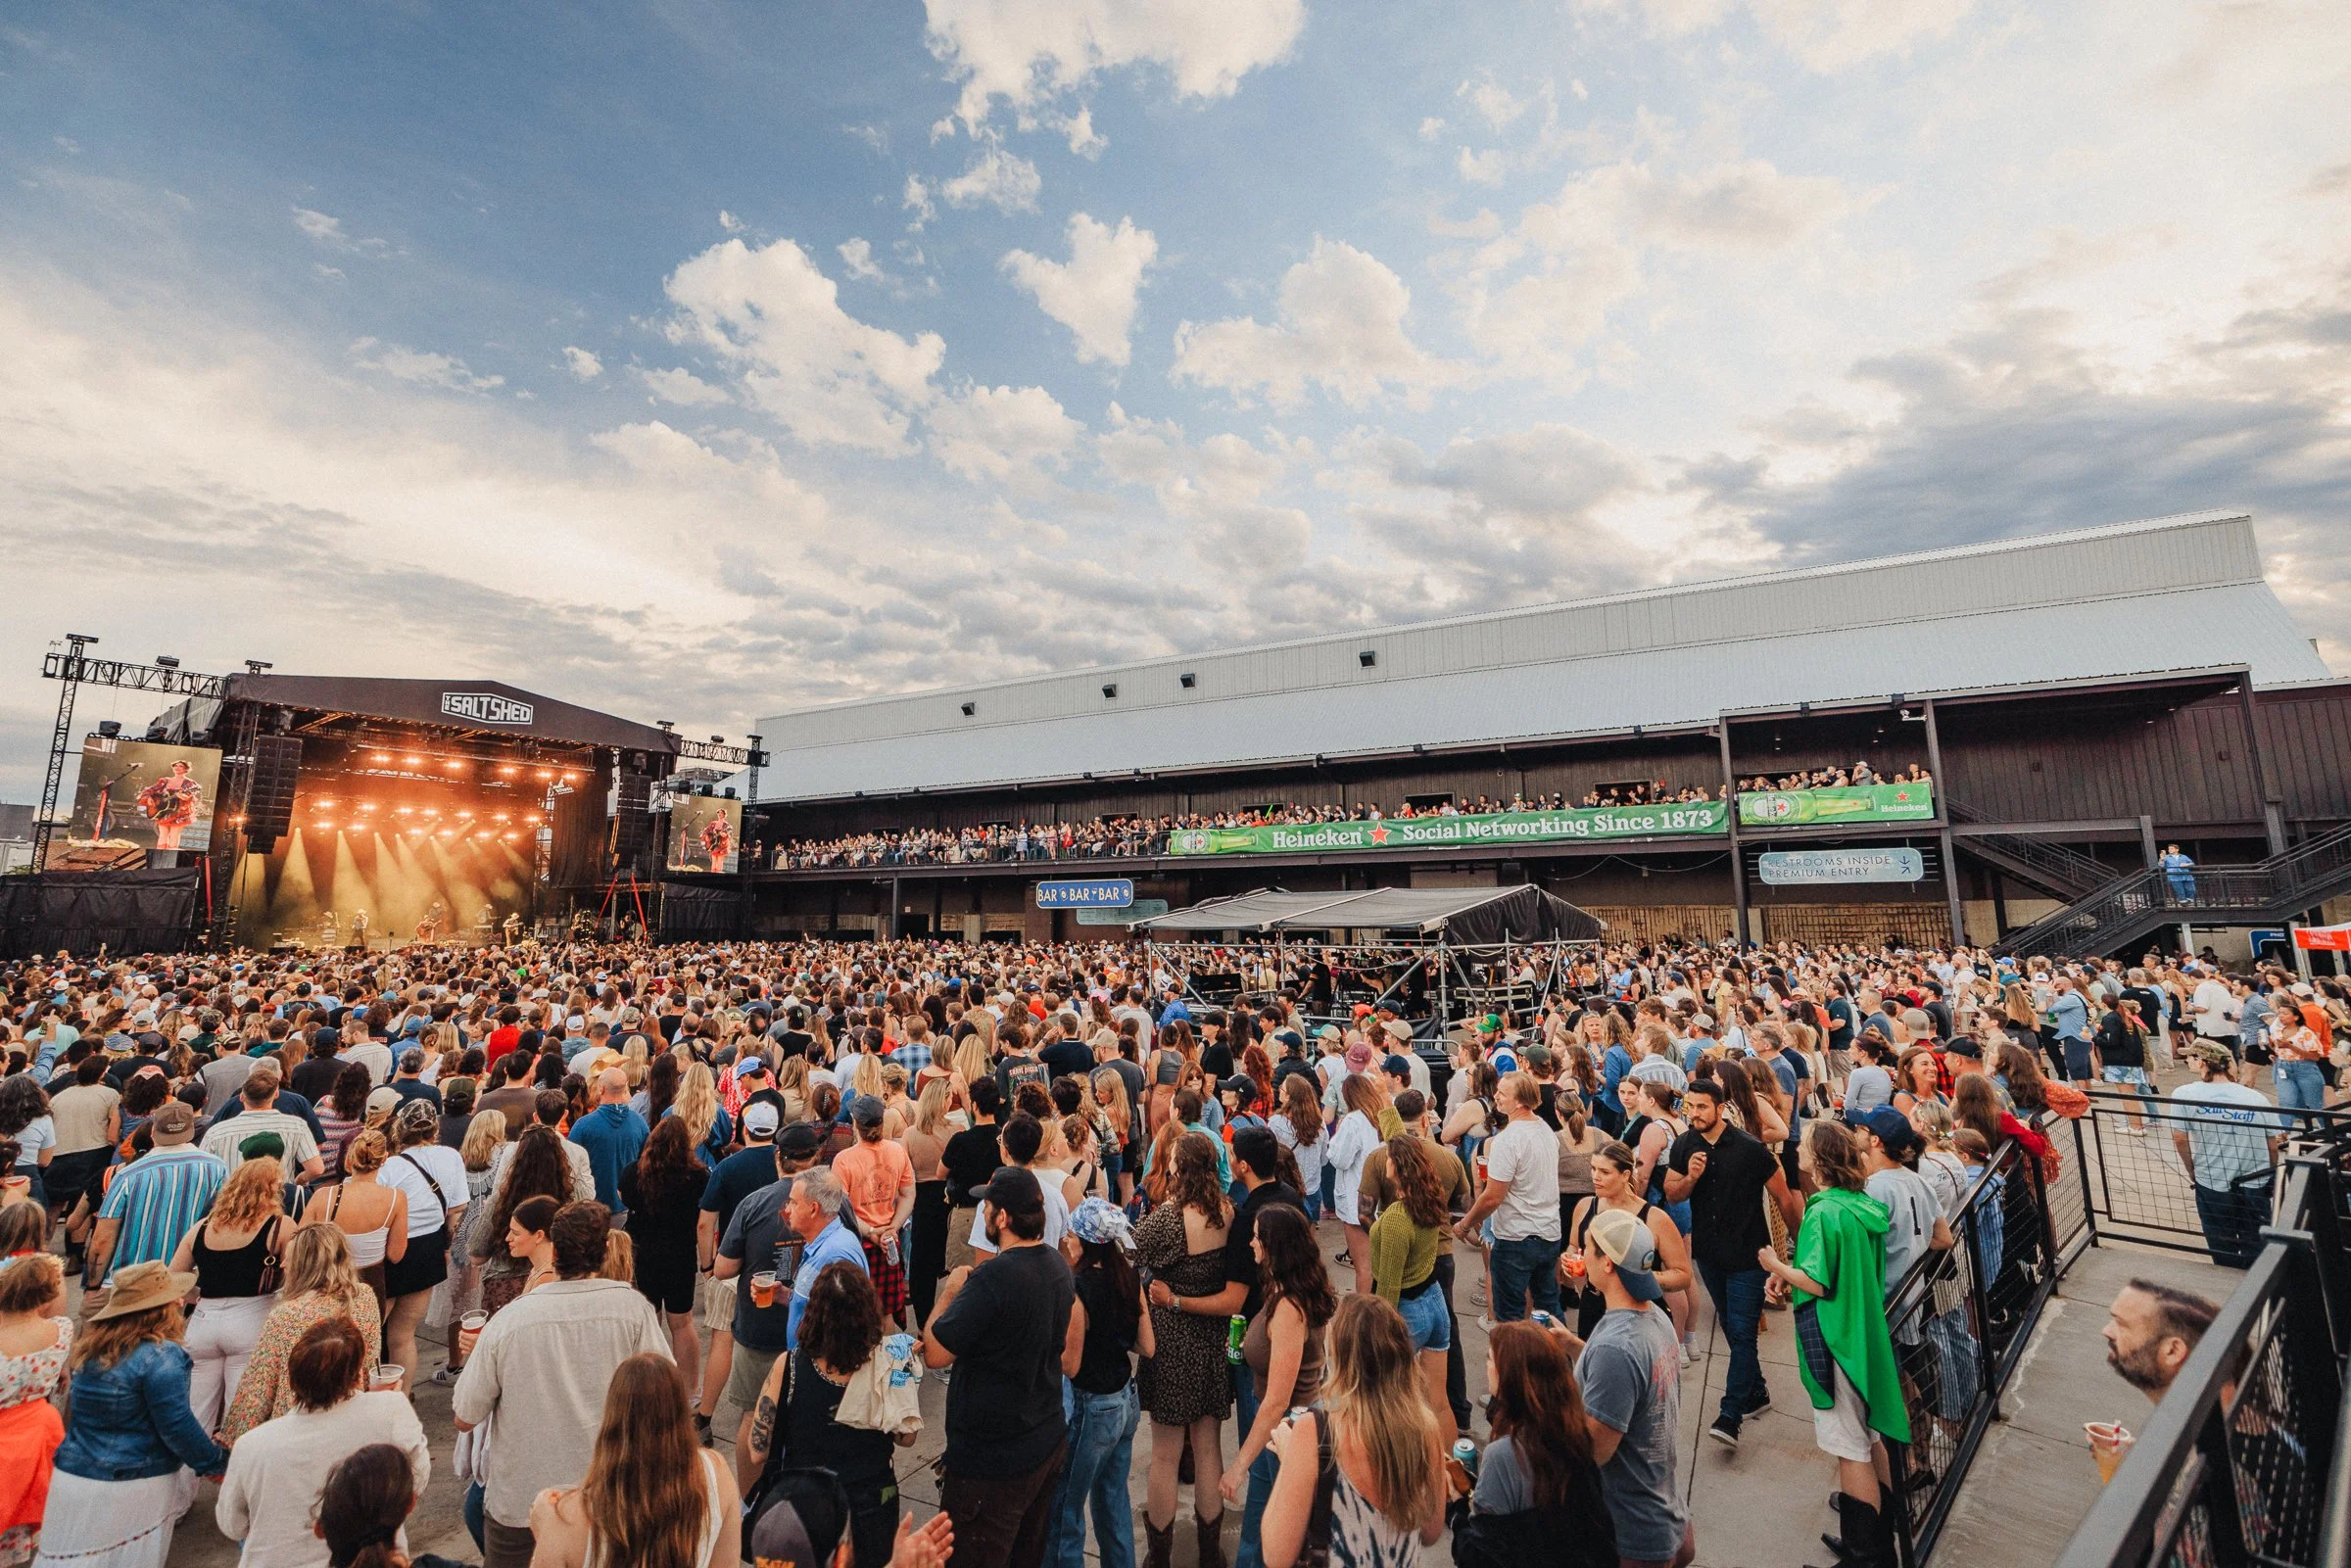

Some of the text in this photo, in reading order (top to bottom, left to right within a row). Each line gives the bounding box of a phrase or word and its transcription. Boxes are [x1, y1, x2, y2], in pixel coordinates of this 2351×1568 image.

[1881, 803, 1928, 813] Heineken
[1272, 809, 1713, 848] Heineken Social Networking Since 1873
[1767, 855, 1891, 868] RESTROOMS INSIDE
[1768, 867, 1869, 879] PREMIUM ENTRY
[1037, 886, 1119, 902] BAR BAR BAR
